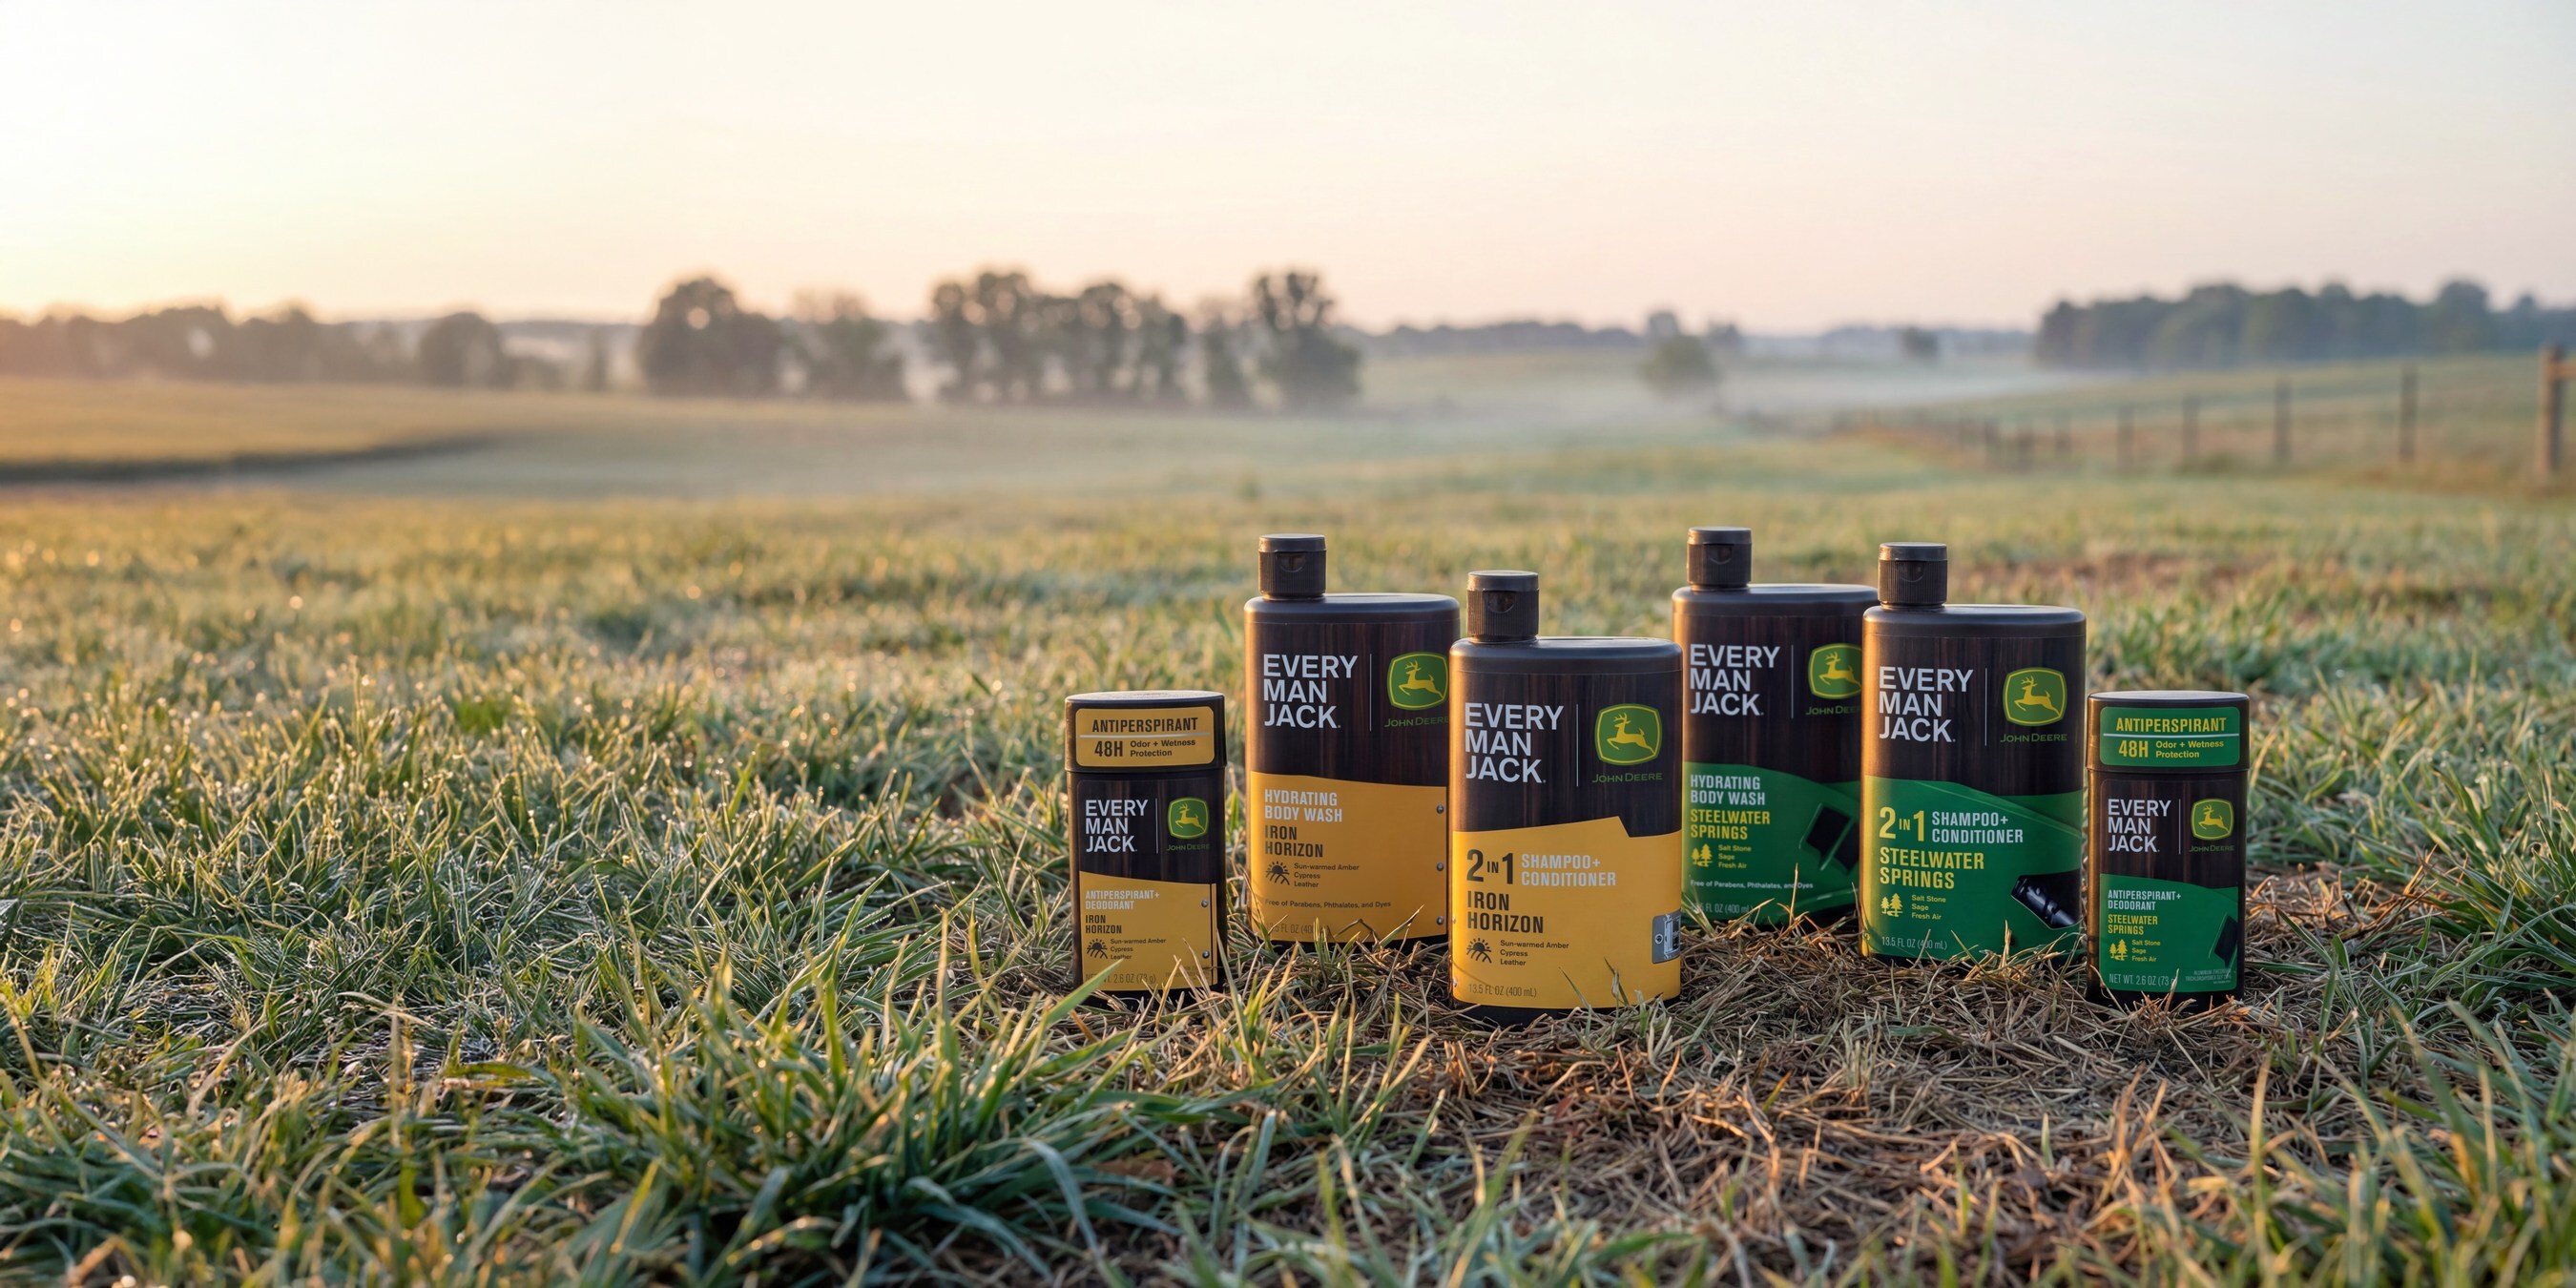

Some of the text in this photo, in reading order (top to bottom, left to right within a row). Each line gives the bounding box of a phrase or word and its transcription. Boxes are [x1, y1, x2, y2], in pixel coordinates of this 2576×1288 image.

[1690, 644, 1780, 668] EVERY
[1263, 654, 1359, 678] EVERY
[1690, 668, 1751, 691] MAN
[1879, 666, 1974, 692] EVERY
[1263, 679, 1327, 703] MAN
[1835, 705, 1860, 714] DEE
[1879, 691, 1942, 717] MAN
[1465, 702, 1565, 730] EVERY
[1091, 717, 1198, 732] ANTIPERSPIRANT
[2115, 717, 2227, 732] ANTIPERSPIRANT
[1094, 740, 1124, 757] 48H
[1465, 729, 1531, 756] MAN
[2118, 740, 2149, 758] 48H
[1690, 775, 1761, 790] HYDRATING
[1264, 789, 1338, 806] HYDRATING
[1690, 790, 1765, 805] BODY WASH
[1085, 800, 1149, 816] EVERY
[1264, 805, 1343, 822] BODY WASH
[2108, 799, 2171, 816] EVERY
[1690, 809, 1771, 824] STEELWATER
[1879, 807, 1924, 841] 2 IN 1
[1931, 811, 2008, 826] SHAMPOO+
[1085, 818, 1129, 834] MAN
[1265, 825, 1298, 840] IRON
[1690, 825, 1748, 840] SPRINGS
[2108, 817, 2150, 834] MAN
[1931, 829, 2024, 843] CONDITIONER
[1265, 841, 1323, 857] HORIZON
[1521, 854, 1601, 869] SHAMPOO+
[1880, 847, 1984, 869] STEELWATER
[1466, 849, 1514, 884] 2 IN 1
[1521, 872, 1616, 886] CONDITIONER
[1880, 867, 1955, 889] SPRINGS
[1085, 890, 1159, 899] ANTIPERSPIRANT+
[1466, 891, 1510, 910] IRON
[2108, 890, 2181, 900] ANTIPERSPIRANT+
[1085, 901, 1135, 909] DEODORANT
[2108, 901, 2156, 910] DEODORANT
[1085, 915, 1106, 924] IRON
[1466, 912, 1544, 933] HORIZON
[2108, 914, 2158, 924] STEELWATER
[2108, 924, 2144, 935] SPRINGS
[1500, 940, 1545, 948] Sun-warmed
[1881, 936, 1896, 946] 13.5
[1898, 938, 1905, 947] FL
[1906, 939, 1916, 947] OZ
[1934, 941, 1947, 949] mL)
[1113, 974, 1124, 983] 2.6
[1126, 974, 1134, 983] OZ
[2109, 974, 2122, 984] NET
[2136, 975, 2147, 985] 2.6
[2148, 976, 2157, 986] OZ
[2158, 976, 2170, 987] (73
[1506, 987, 1523, 997] (400
